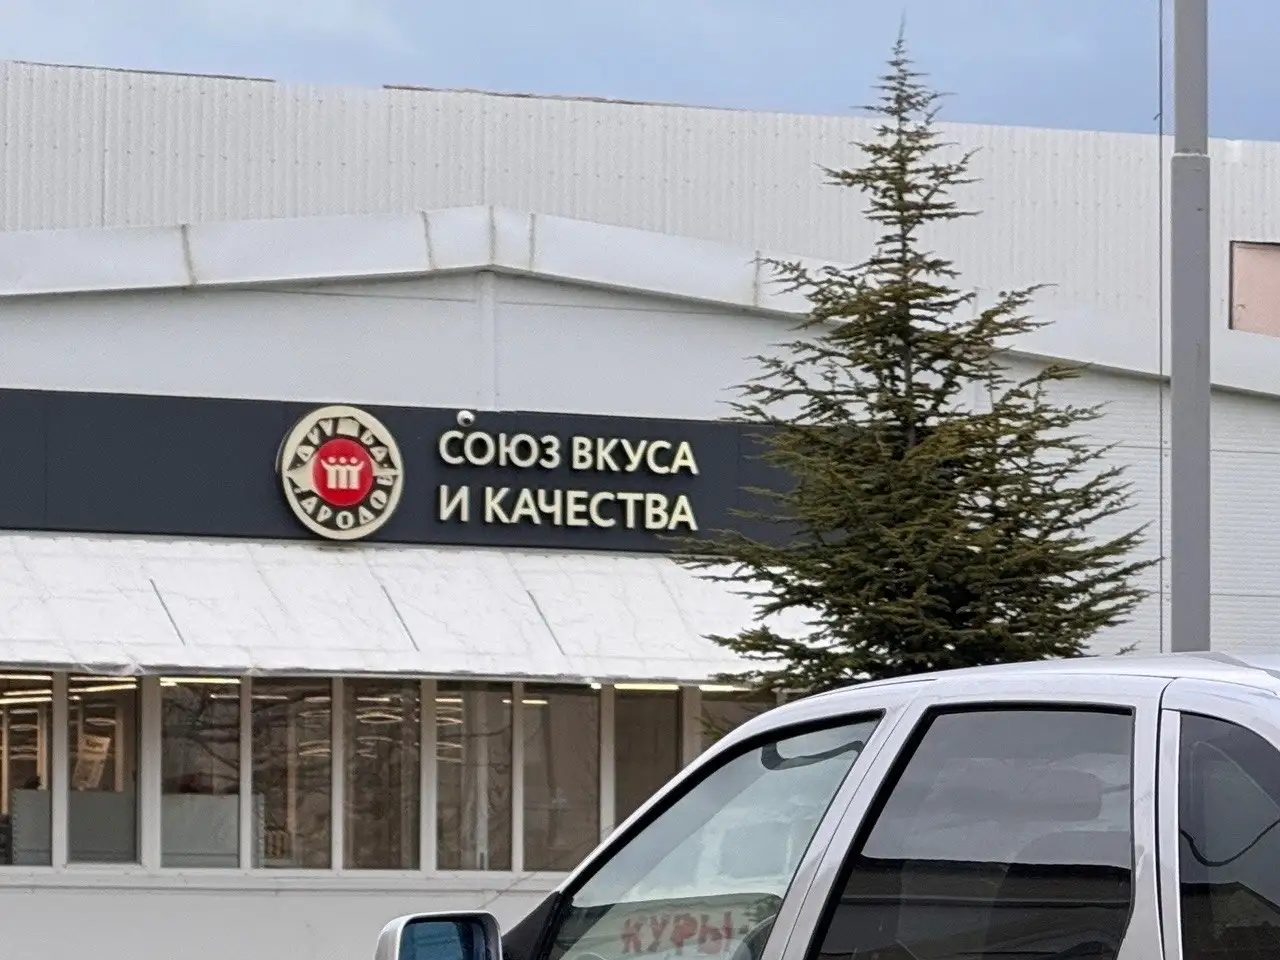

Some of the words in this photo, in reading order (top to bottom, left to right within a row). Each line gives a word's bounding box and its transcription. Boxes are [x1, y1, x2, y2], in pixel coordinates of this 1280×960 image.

[296, 416, 389, 462] ДРУБА
[439, 430, 561, 469] СОЮЗ
[572, 437, 700, 476] ВКУСА
[293, 475, 394, 530] АРОДОВ
[439, 485, 468, 522] И
[484, 487, 699, 532] КАЧЕСТВА
